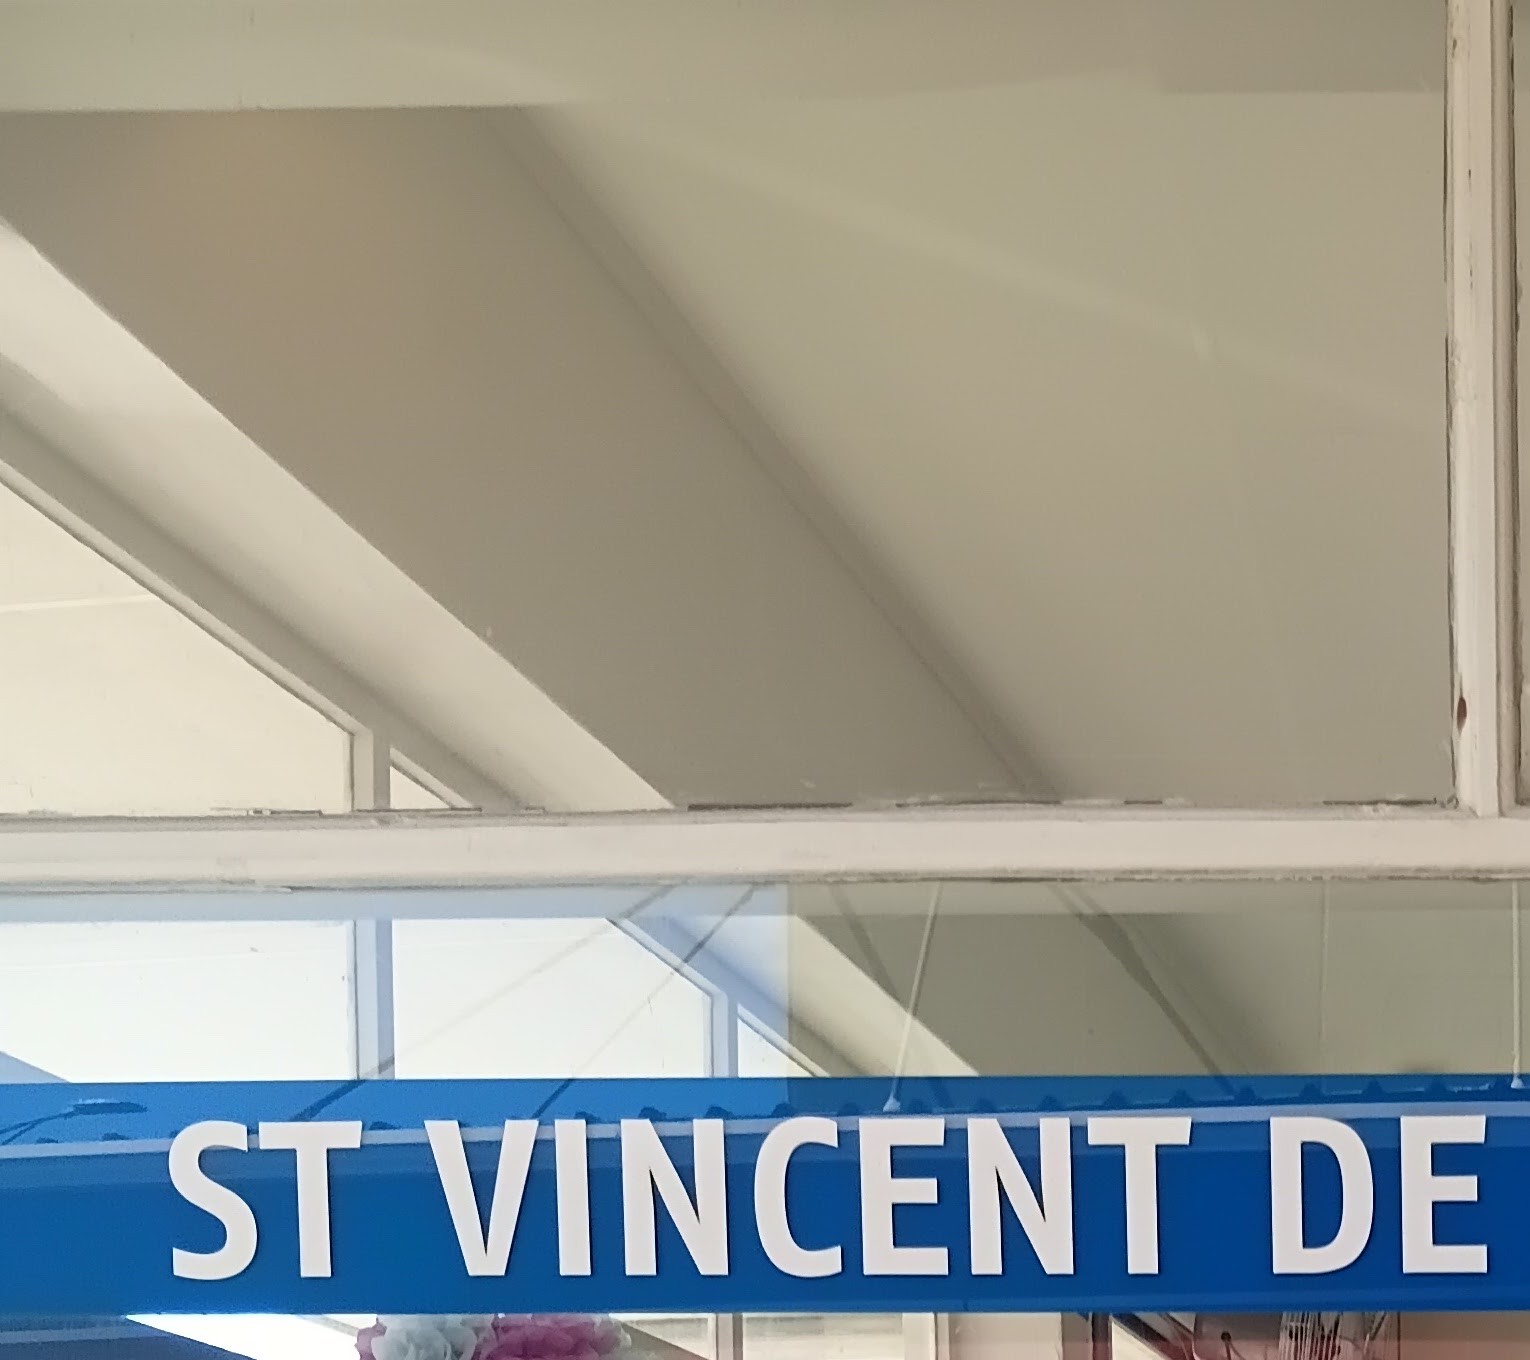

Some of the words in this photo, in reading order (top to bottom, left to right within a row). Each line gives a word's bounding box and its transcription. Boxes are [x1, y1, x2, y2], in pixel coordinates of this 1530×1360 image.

[169, 1119, 363, 1280] ST
[424, 1115, 1192, 1278] VINCENT
[1271, 1114, 1488, 1275] DE
